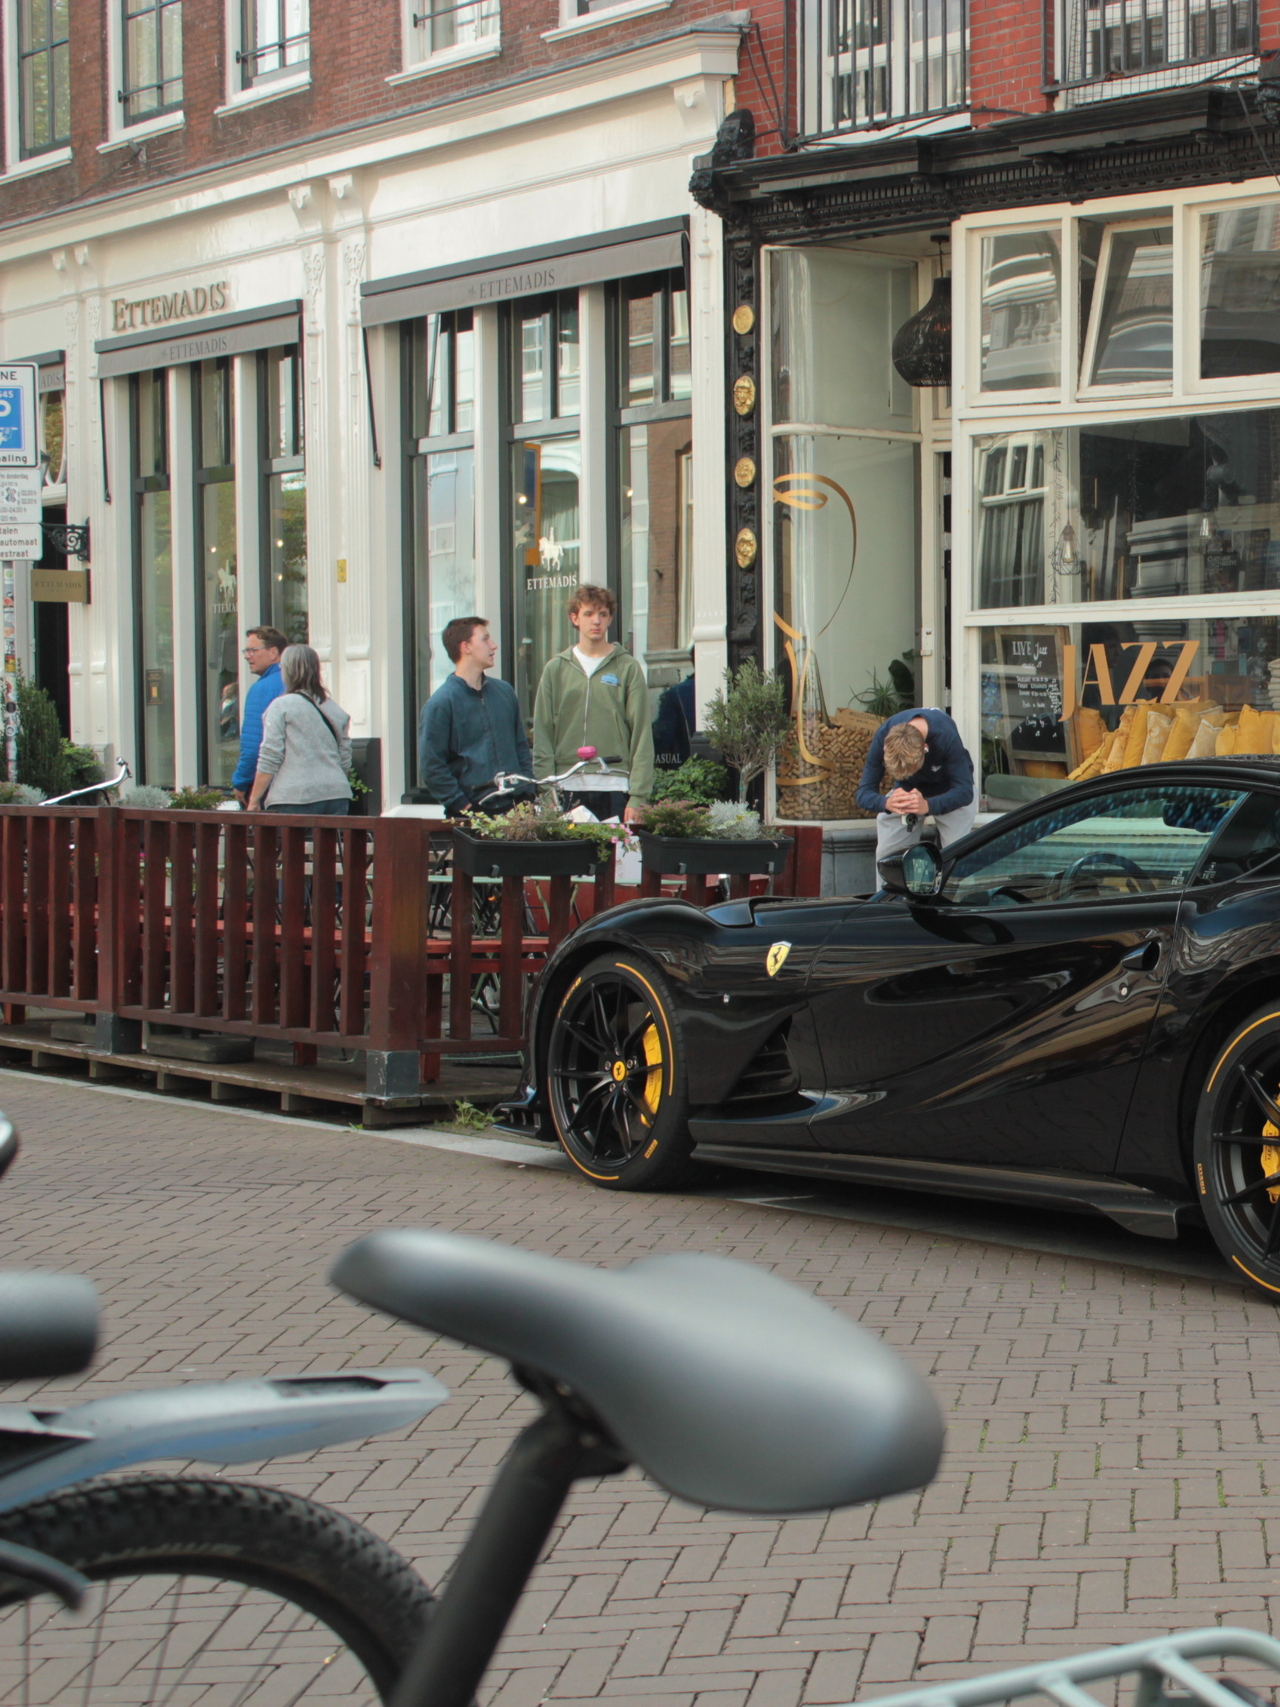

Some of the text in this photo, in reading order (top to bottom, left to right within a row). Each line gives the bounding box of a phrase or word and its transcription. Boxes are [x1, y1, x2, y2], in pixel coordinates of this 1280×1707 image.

[480, 269, 555, 299] ETTEMADIS
[169, 337, 228, 360] ETTEMADIS
[40, 371, 60, 388] ADIS
[0, 454, 28, 464] aling
[527, 575, 577, 590] ETTEMADIS
[1012, 641, 1032, 656] LIVE
[1058, 640, 1200, 722] JAZZ
[654, 753, 682, 764] ASUAL
